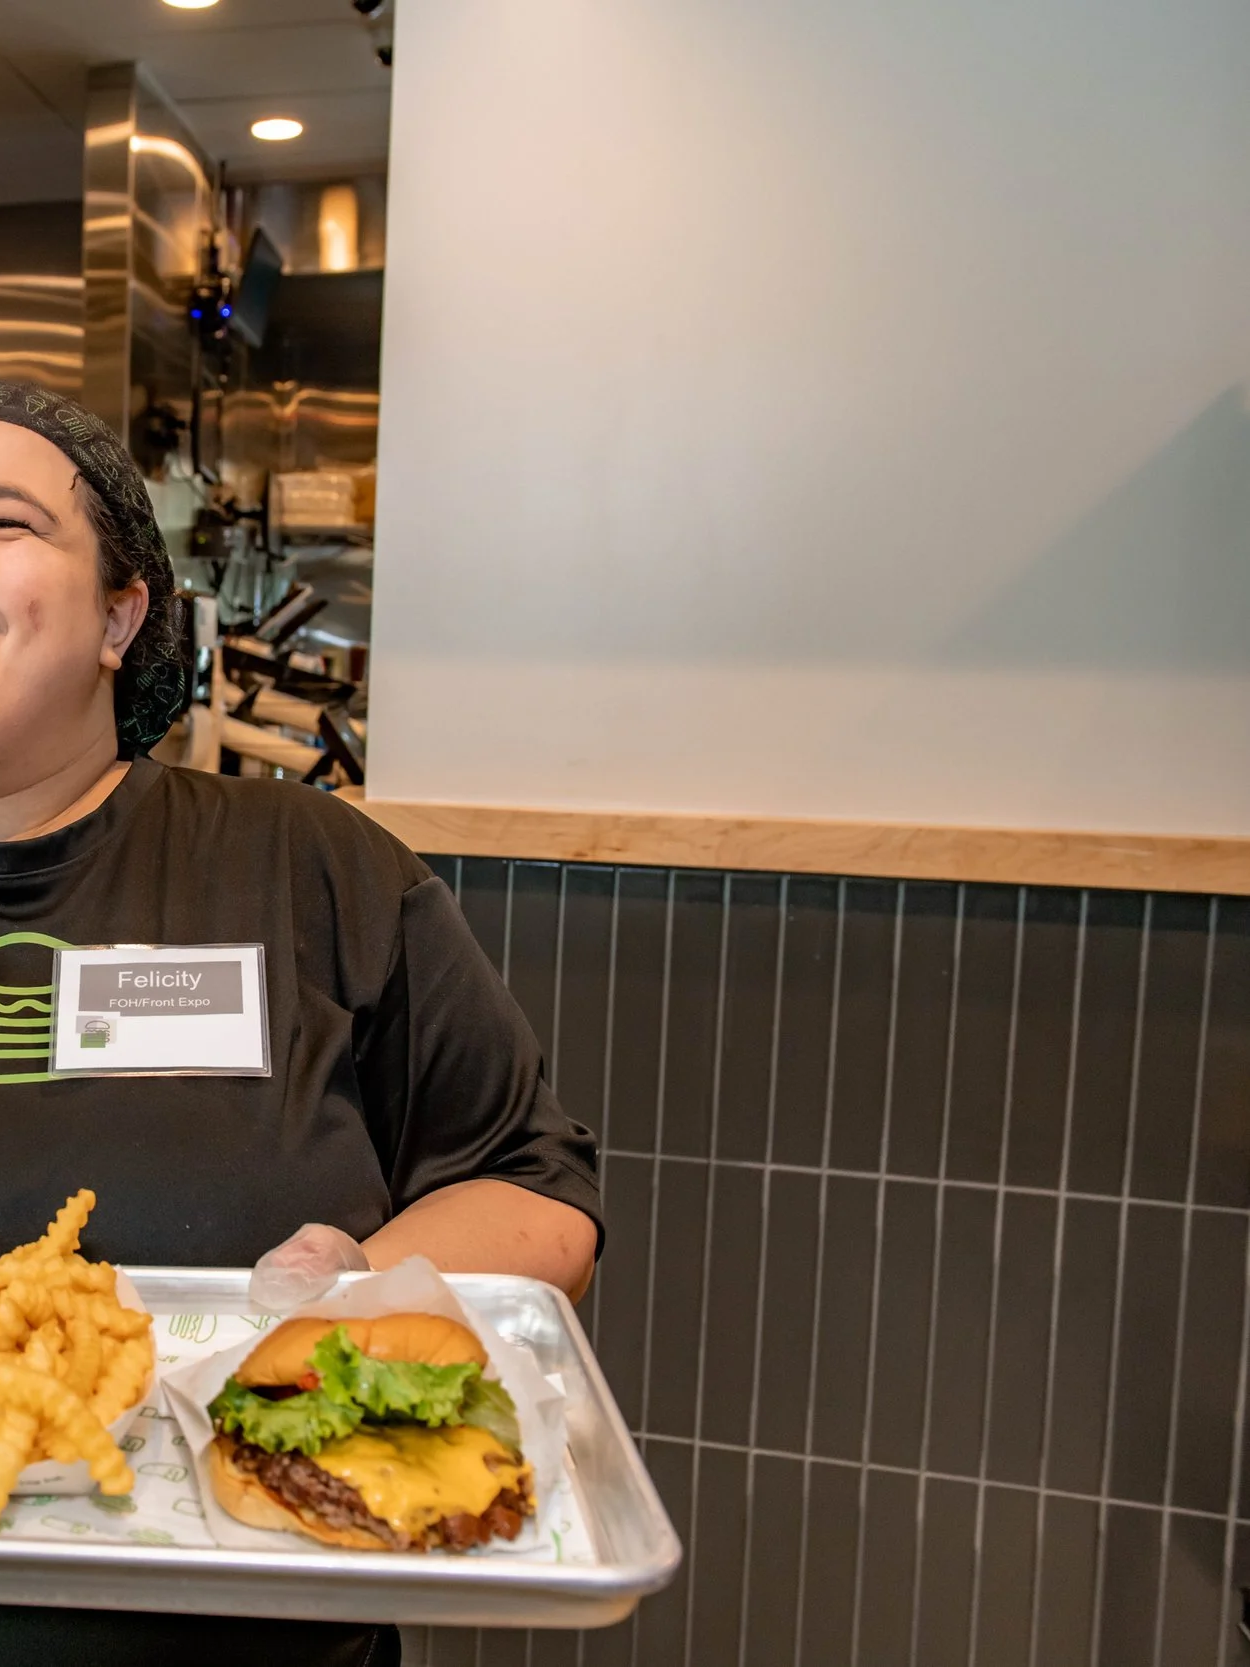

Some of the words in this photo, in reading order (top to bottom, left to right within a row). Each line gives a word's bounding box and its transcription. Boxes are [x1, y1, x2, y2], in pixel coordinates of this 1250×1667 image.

[117, 970, 203, 990] Felicity
[109, 998, 175, 1009] FOH/Front
[178, 997, 211, 1008] Expo
